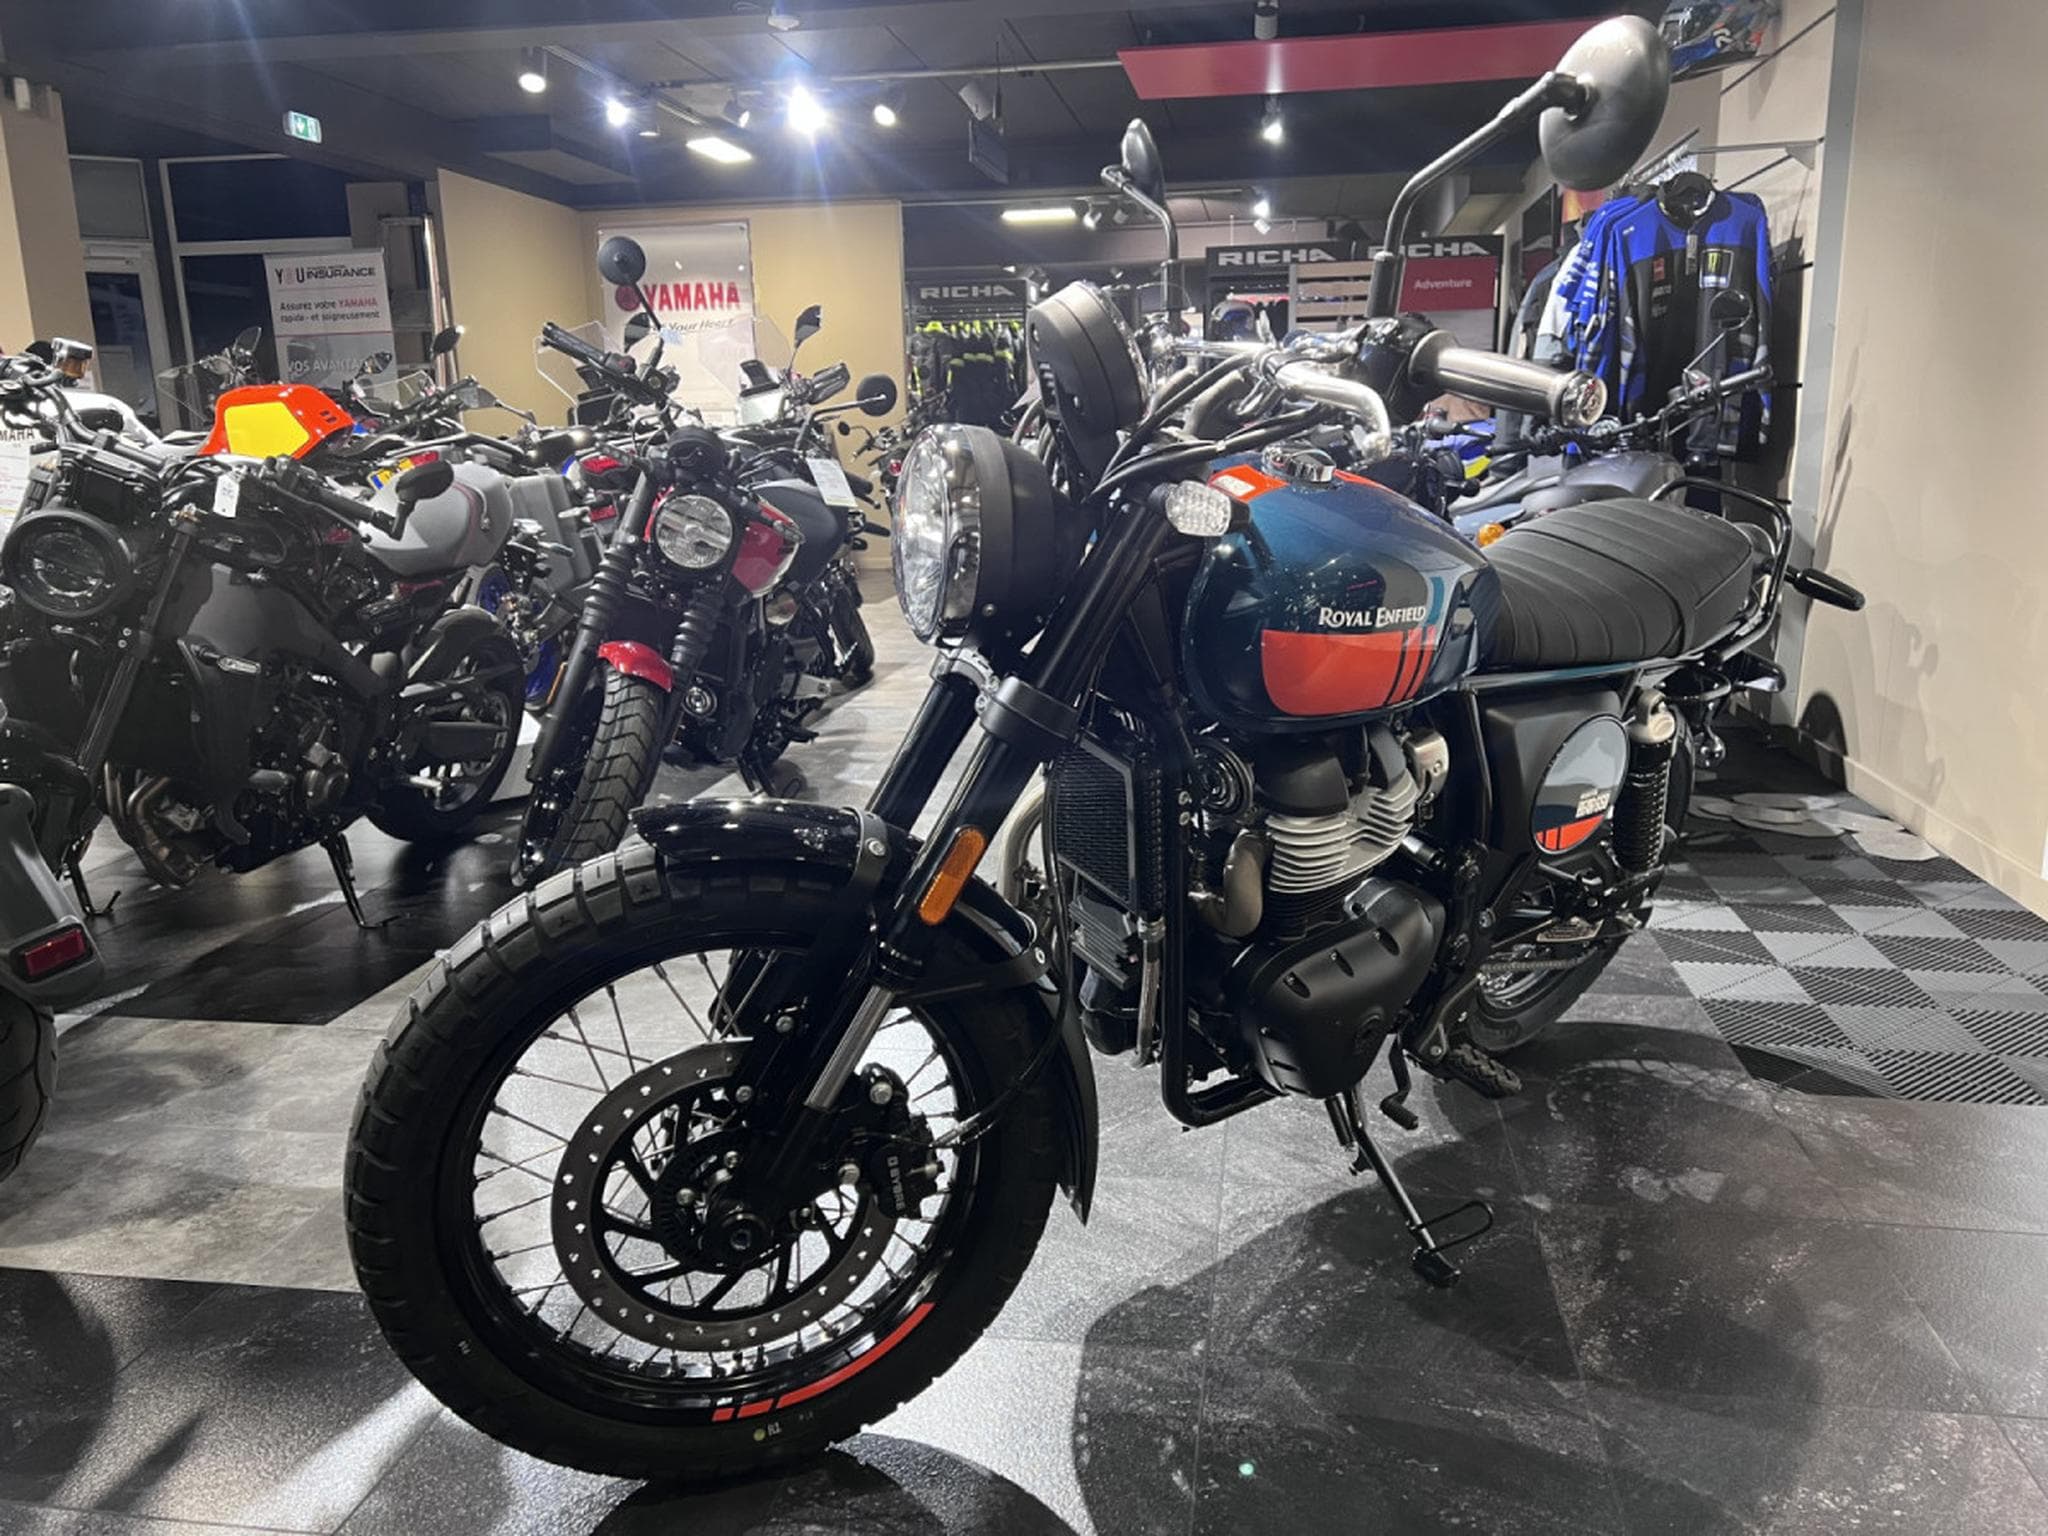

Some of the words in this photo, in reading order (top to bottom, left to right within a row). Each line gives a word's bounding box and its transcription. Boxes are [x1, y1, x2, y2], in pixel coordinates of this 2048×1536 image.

[1218, 249, 1337, 266] RICHA
[306, 266, 376, 280] INSURANCE
[1414, 278, 1473, 290] Adventure
[643, 281, 741, 312] YAMAHA
[920, 285, 1016, 300] RICHA
[338, 298, 378, 308] YAMAHA
